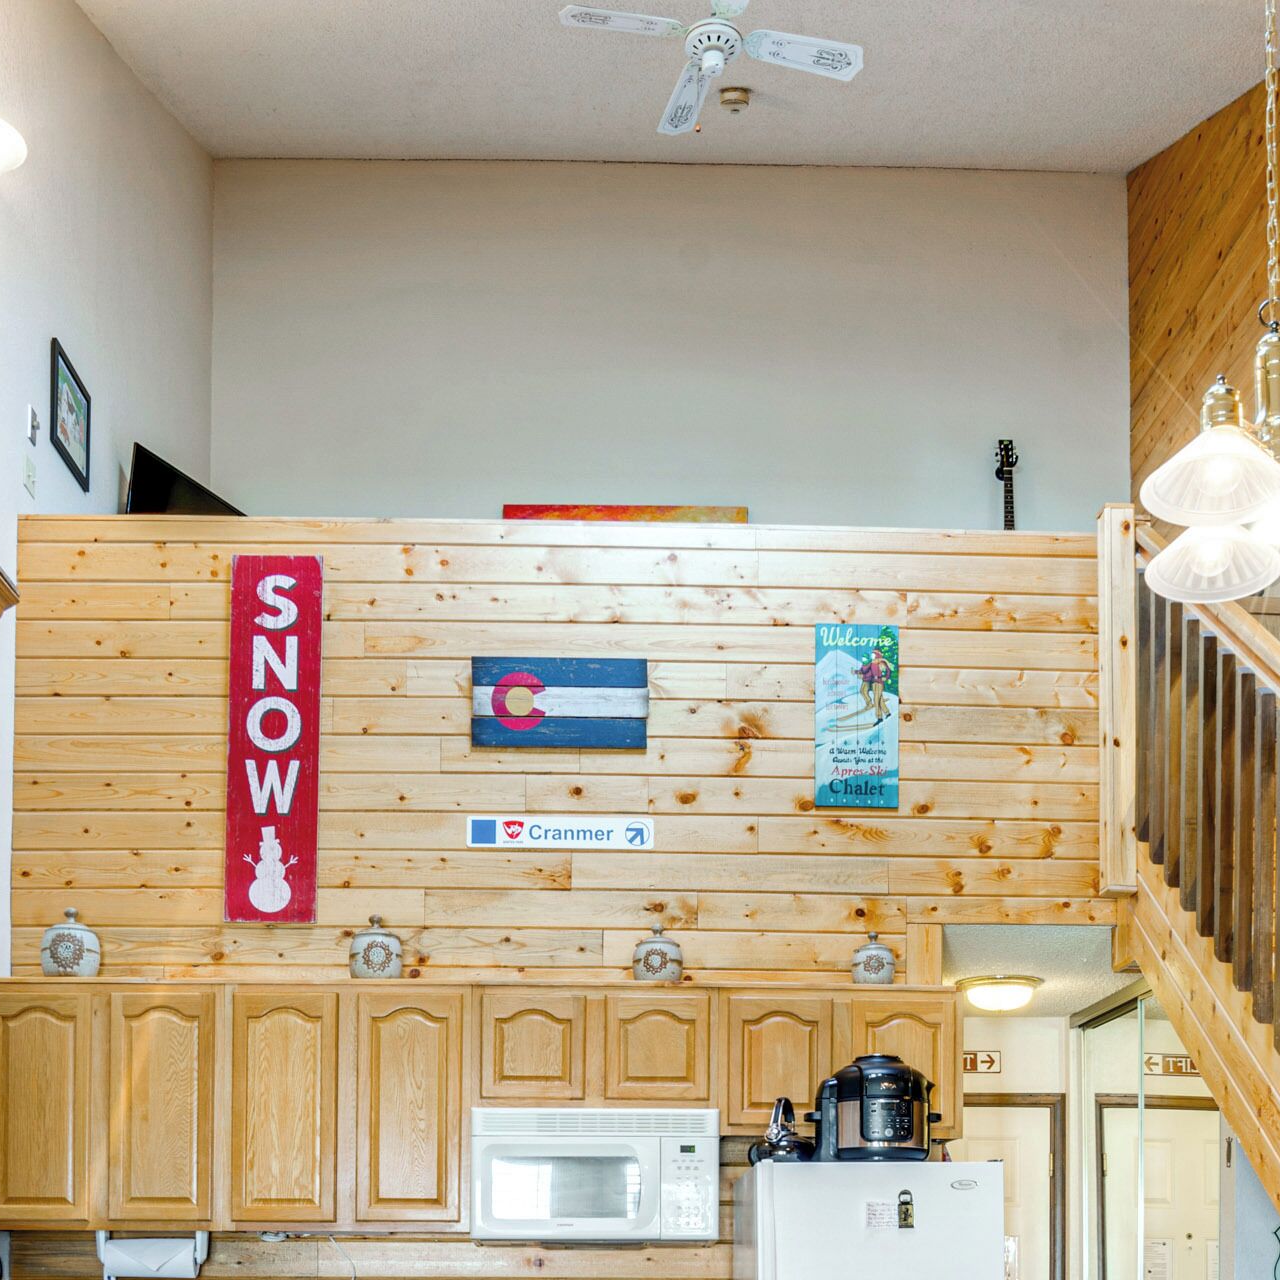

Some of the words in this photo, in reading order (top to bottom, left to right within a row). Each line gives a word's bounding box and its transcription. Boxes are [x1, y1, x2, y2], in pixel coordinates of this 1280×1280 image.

[820, 626, 894, 647] Welcome
[245, 574, 302, 816] SNOW
[829, 778, 886, 796] Chalet
[529, 824, 614, 841] Cranmer
[963, 1054, 975, 1070] T
